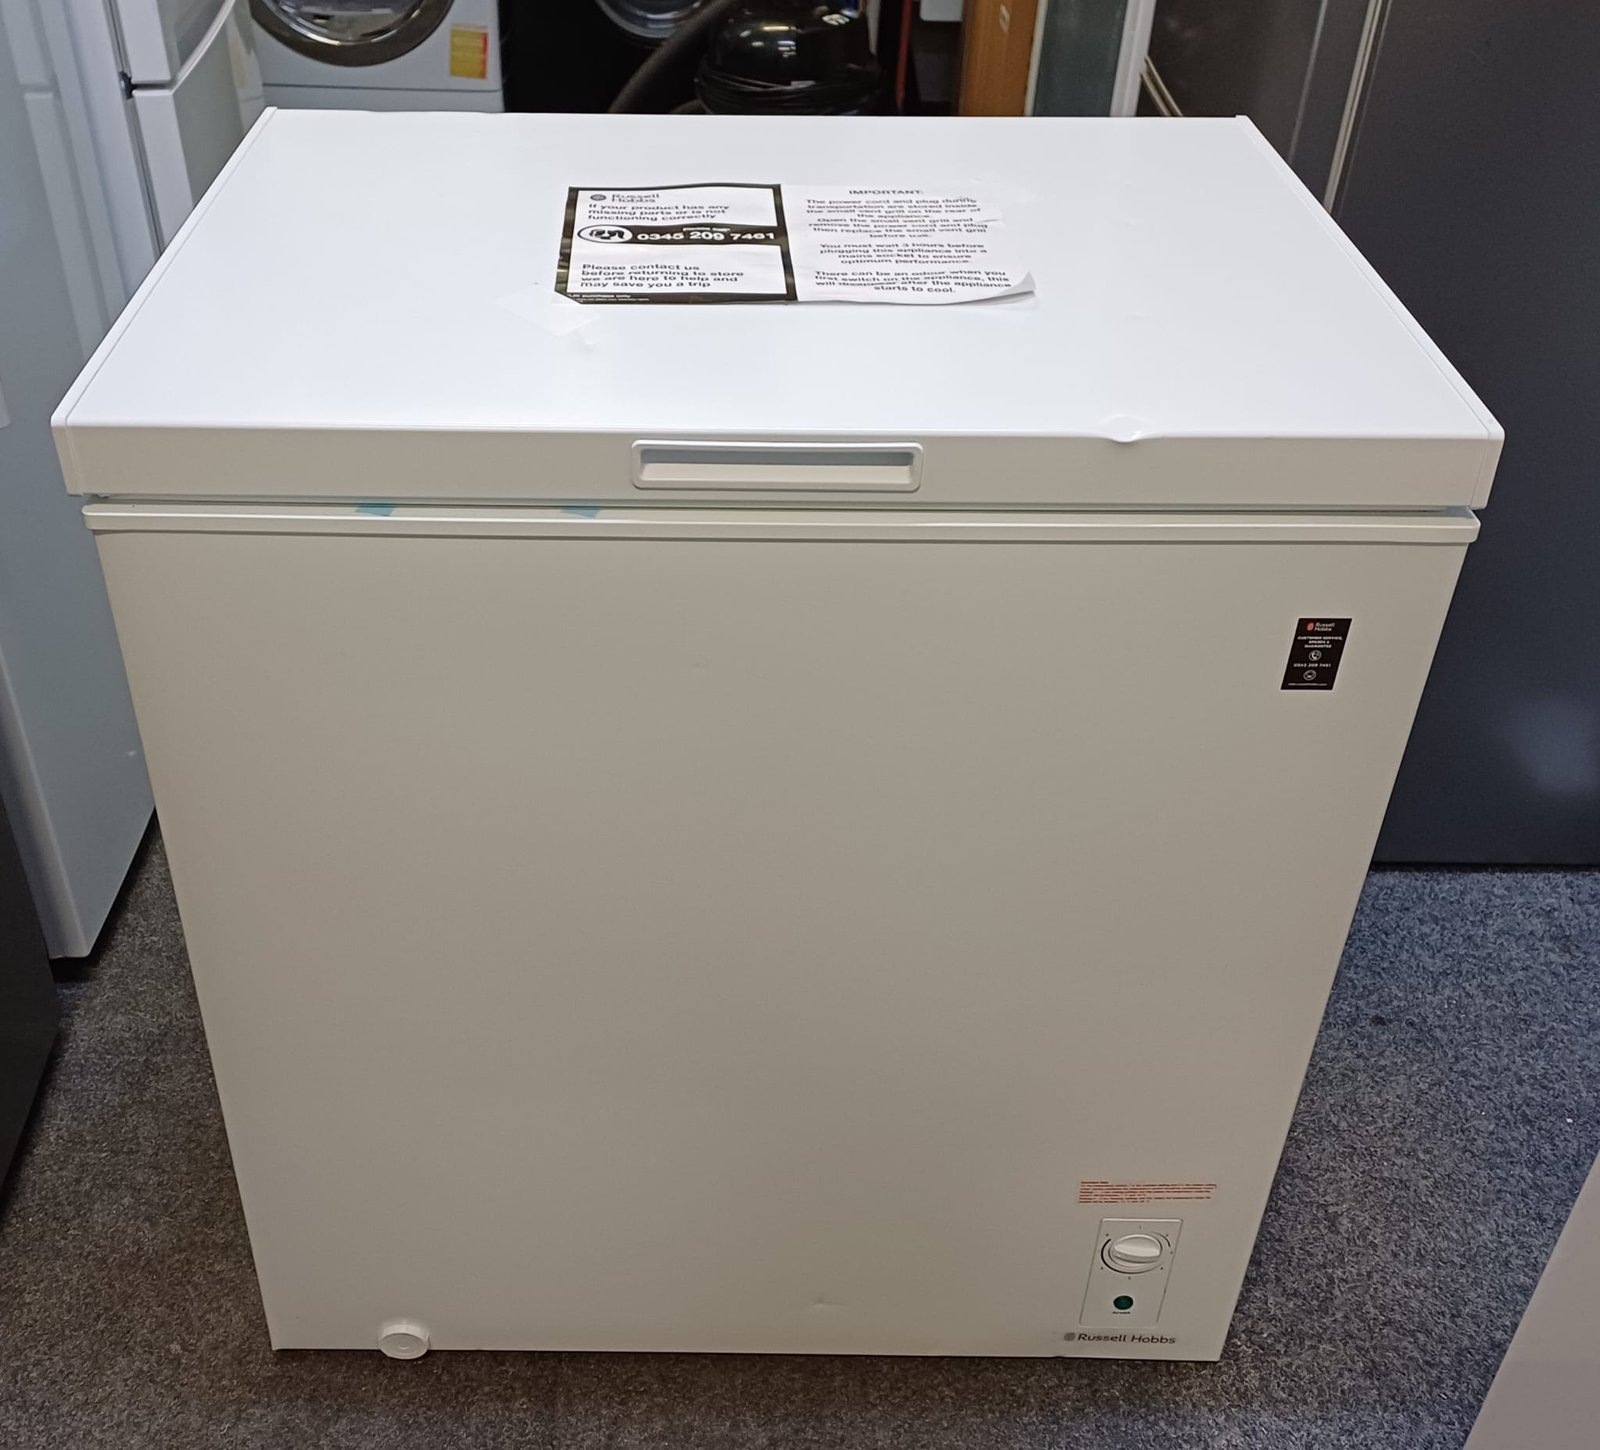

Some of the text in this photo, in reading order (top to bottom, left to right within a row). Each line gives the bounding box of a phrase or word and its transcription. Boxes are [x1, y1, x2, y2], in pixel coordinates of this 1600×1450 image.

[637, 232, 685, 240] 0345
[689, 231, 725, 241] 209
[1077, 1333, 1176, 1345] Russell Hobbs
